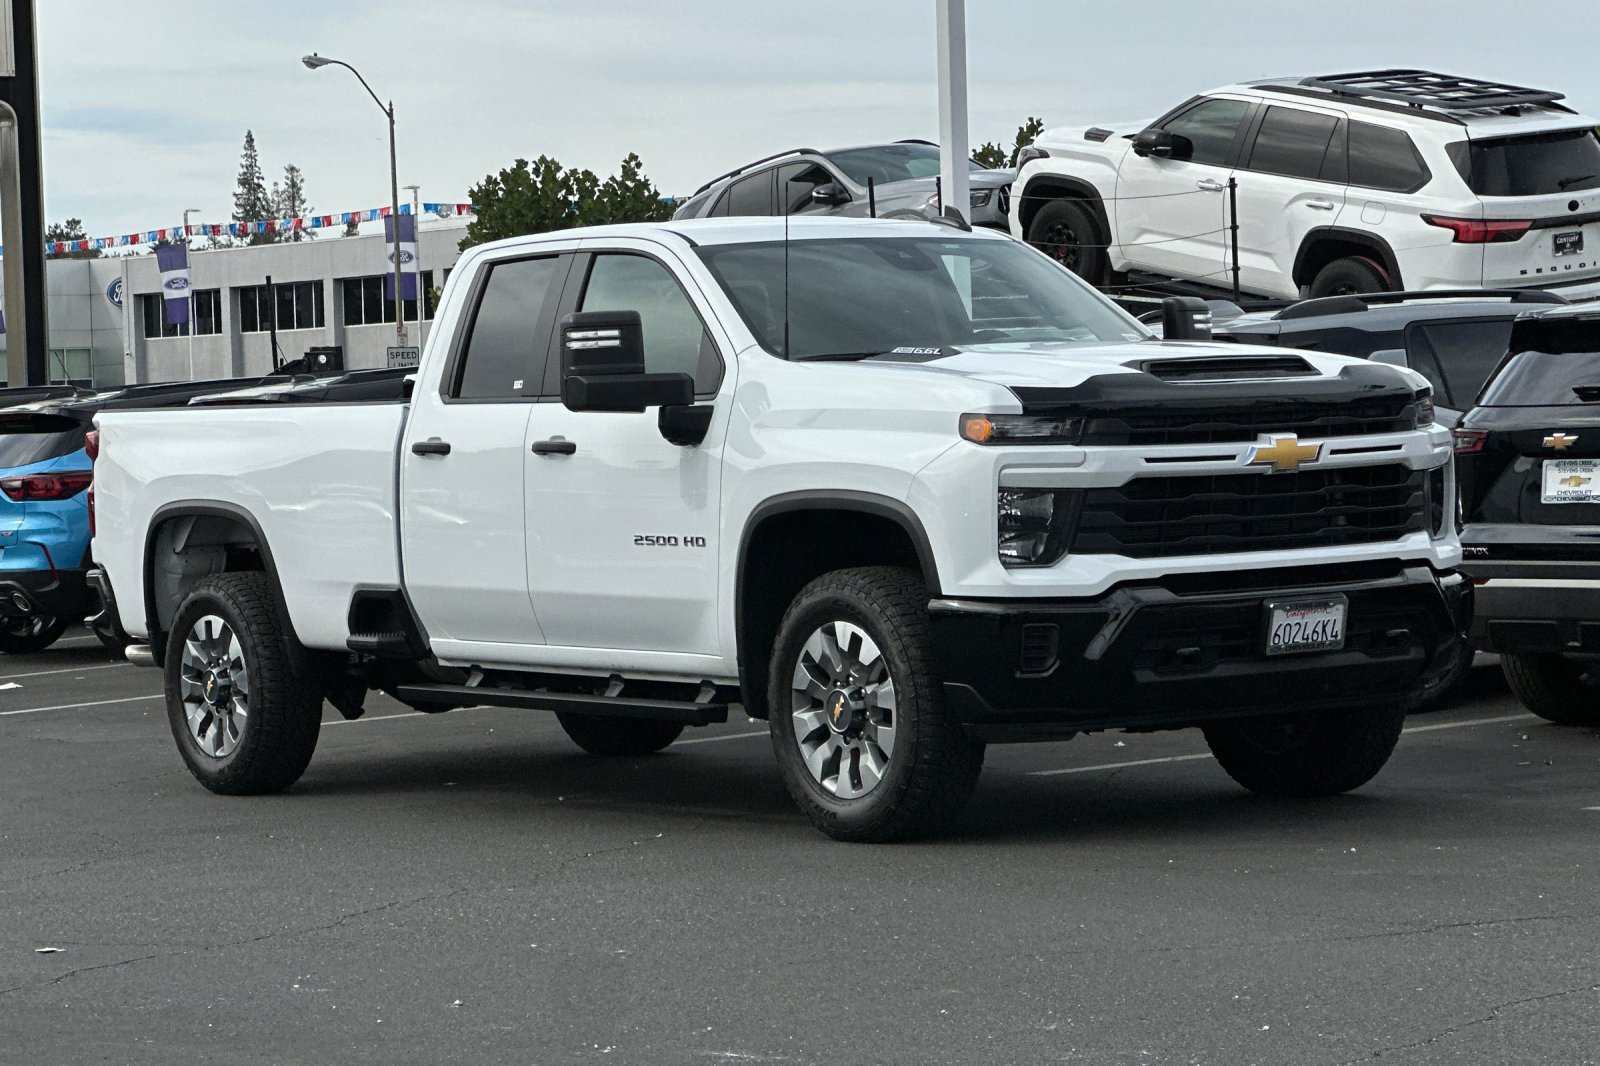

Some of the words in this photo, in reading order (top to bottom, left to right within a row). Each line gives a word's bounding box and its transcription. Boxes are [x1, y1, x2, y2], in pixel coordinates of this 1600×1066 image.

[1520, 261, 1597, 275] SEQUOI
[389, 351, 417, 360] SPEED
[633, 535, 679, 546] 2500
[683, 536, 706, 547] HD
[1272, 618, 1339, 645] 60246K4
